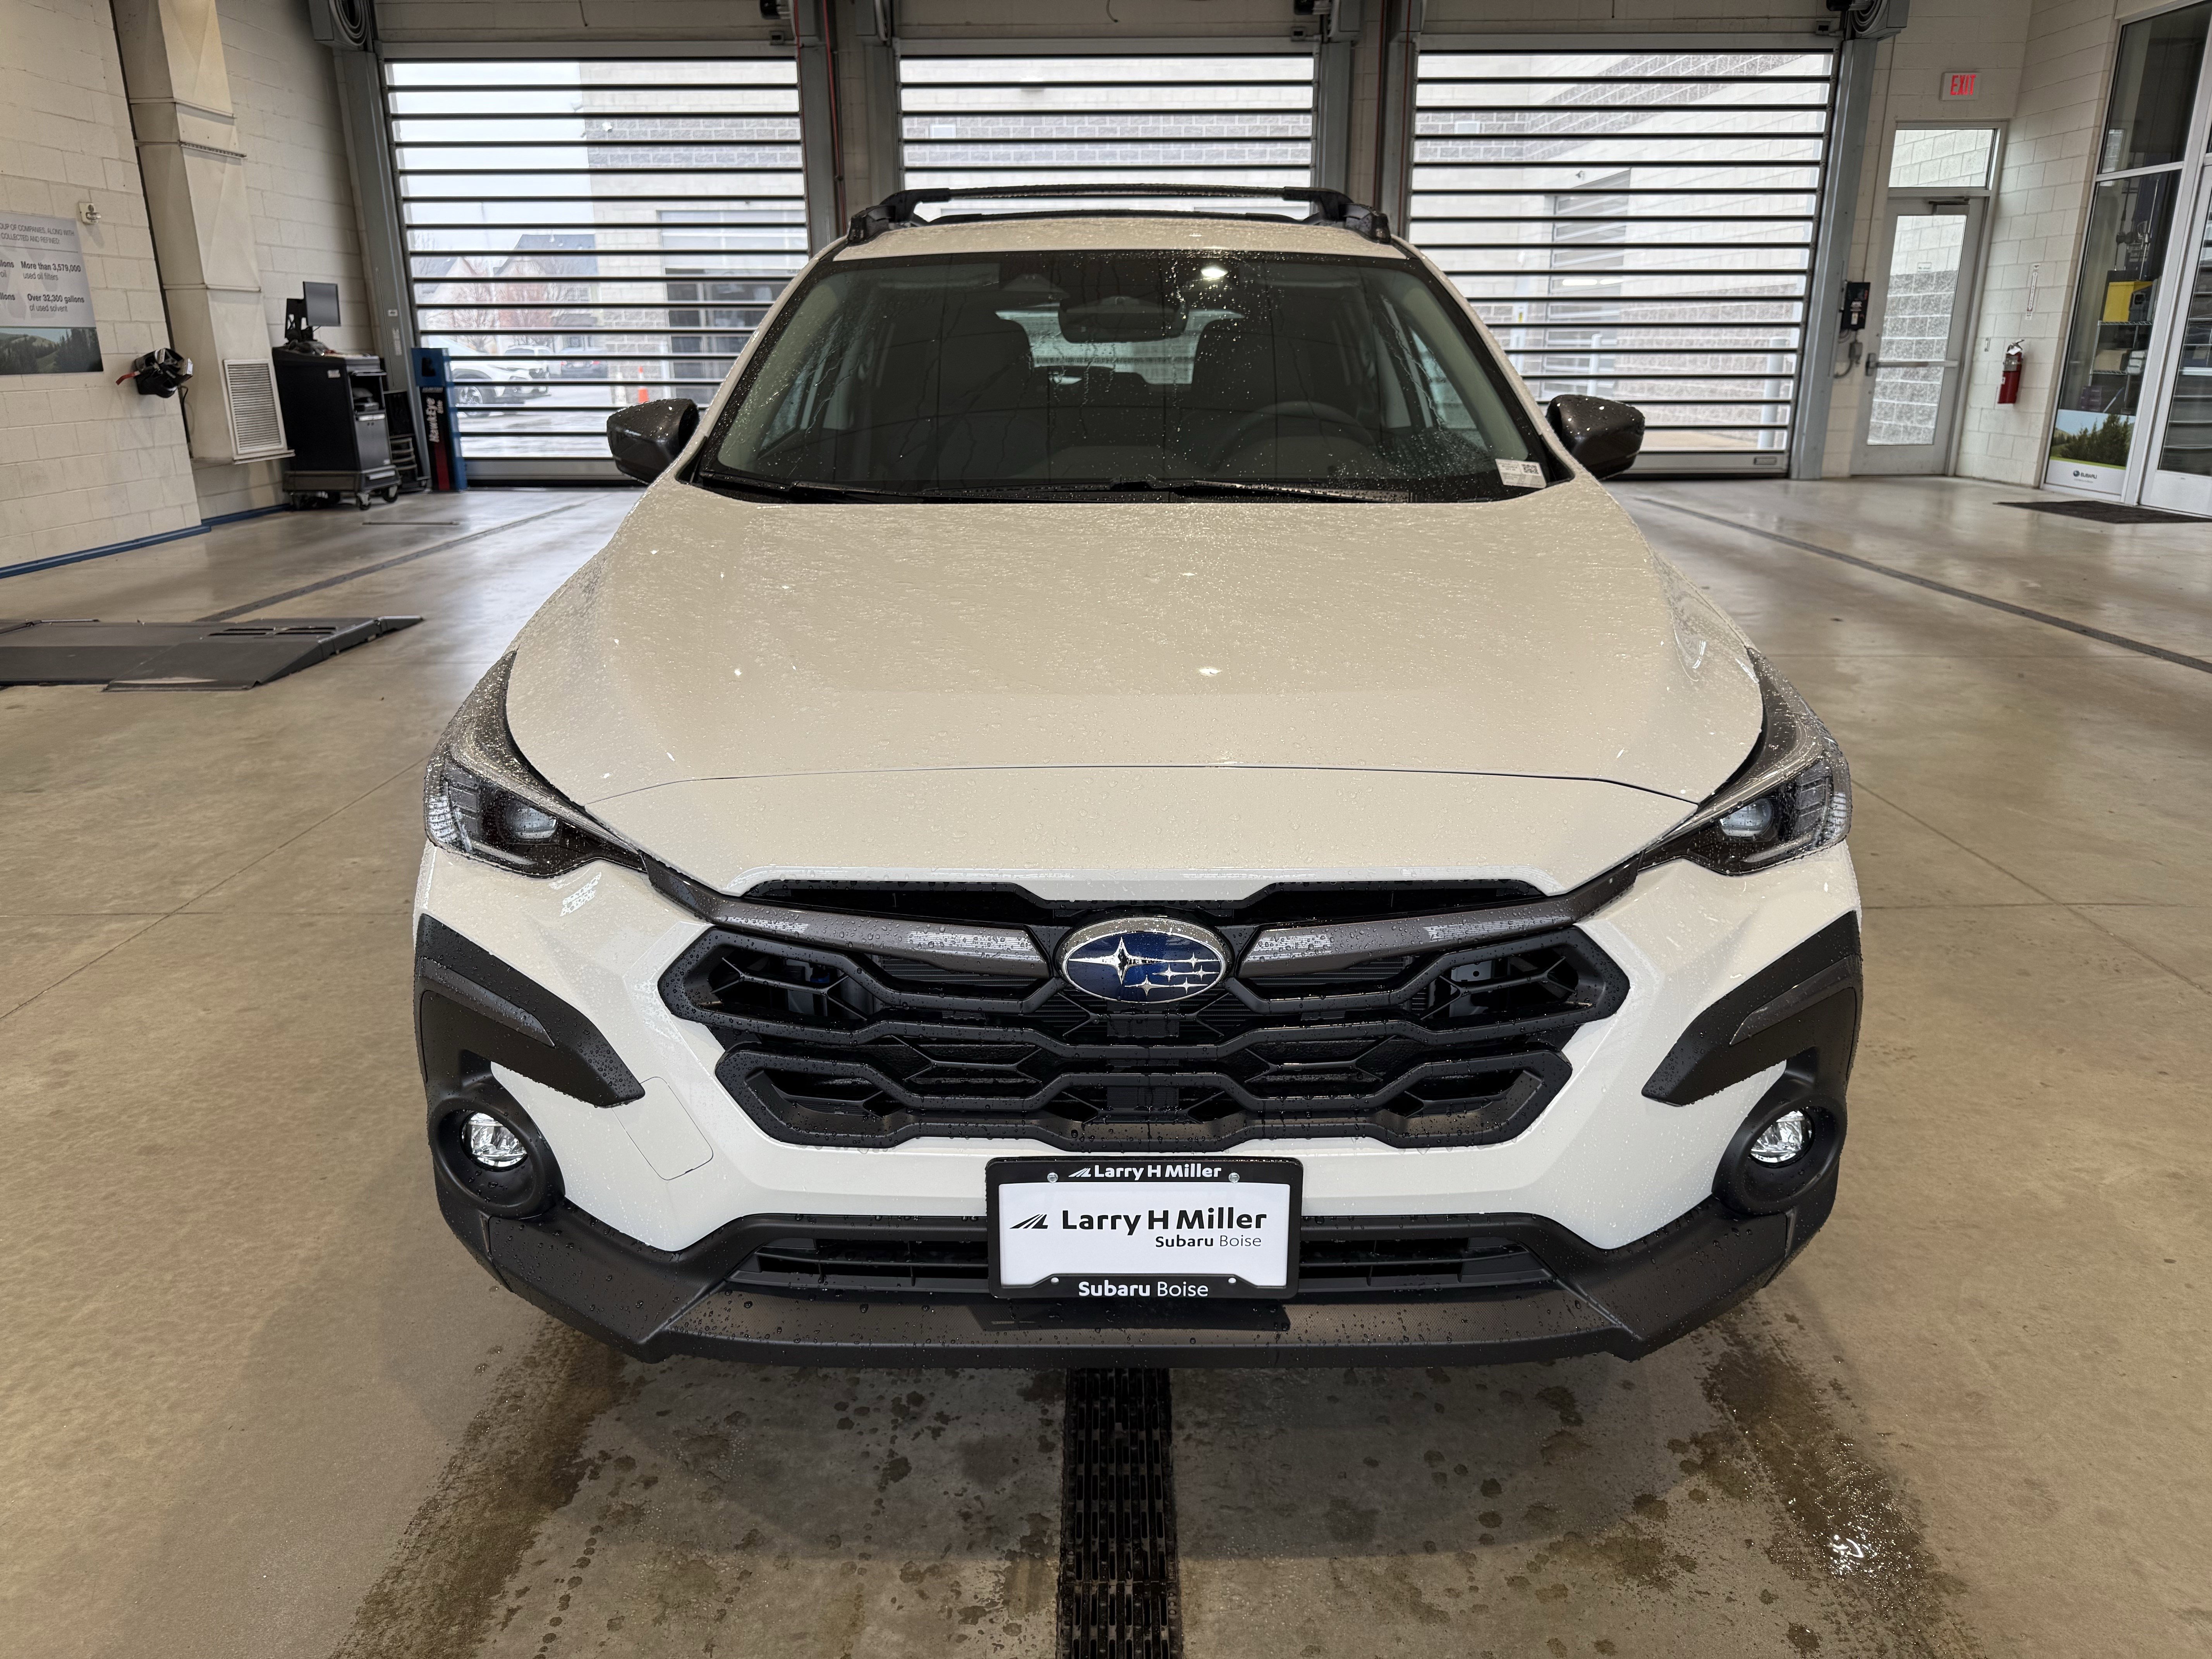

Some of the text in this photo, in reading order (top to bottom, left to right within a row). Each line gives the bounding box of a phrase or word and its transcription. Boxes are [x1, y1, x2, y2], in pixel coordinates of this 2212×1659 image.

[1950, 74, 1977, 95] EXIT
[1, 233, 29, 242] COLLECTED
[21, 261, 81, 273] More than 3,579,000
[44, 273, 58, 281] filters
[43, 294, 63, 303] 32,300
[64, 295, 85, 304] gallons
[1095, 1163, 1221, 1180] Larry H Miller
[1063, 1207, 1267, 1235] Larry H Miller
[1156, 1235, 1261, 1247] Subaru Boise
[1079, 1279, 1208, 1297] Subaru Boise
